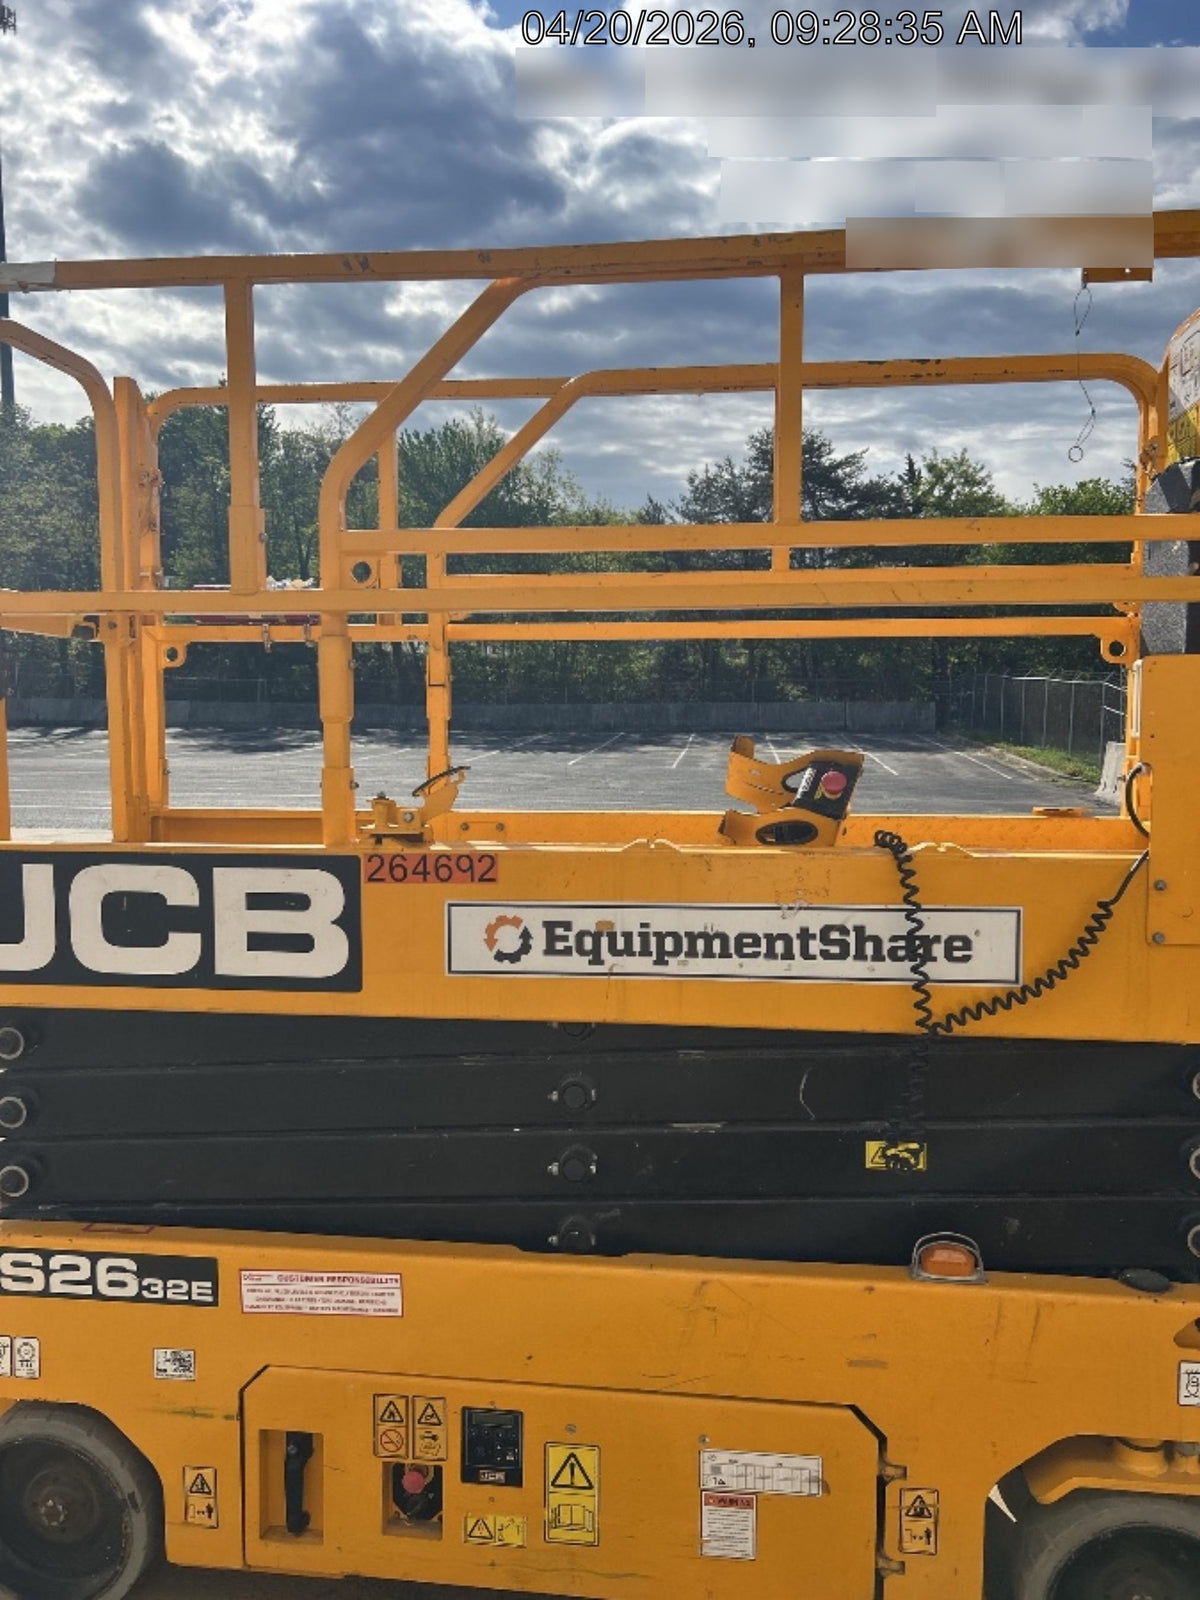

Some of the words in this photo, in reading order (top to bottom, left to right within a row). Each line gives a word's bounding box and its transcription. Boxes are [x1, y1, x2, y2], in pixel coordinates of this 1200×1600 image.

[367, 855, 498, 883] 264692
[0, 863, 350, 979] JCB
[542, 920, 973, 966] EquipmentShare
